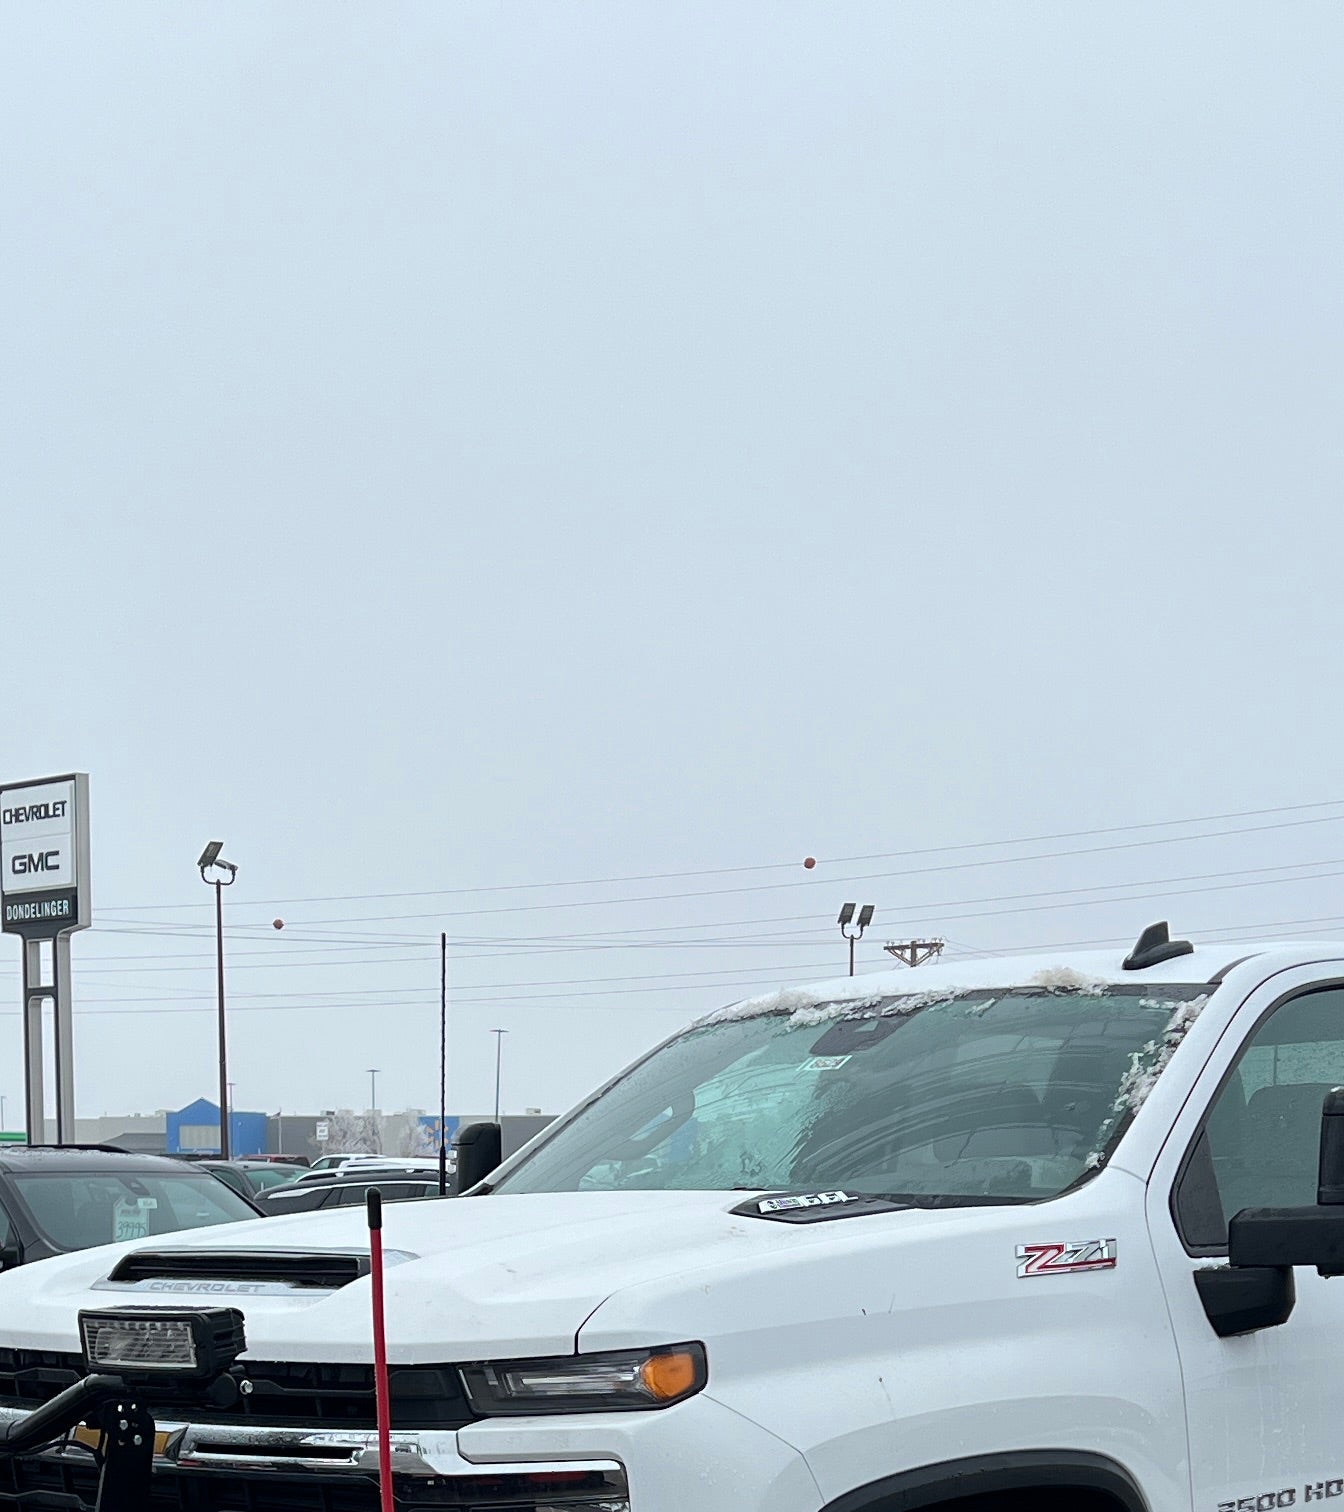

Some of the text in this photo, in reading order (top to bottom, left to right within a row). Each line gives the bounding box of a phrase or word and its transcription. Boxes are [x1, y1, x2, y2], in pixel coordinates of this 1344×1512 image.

[3, 800, 67, 825] CHEVROLET
[12, 850, 60, 875] GMC
[6, 899, 69, 921] DONDELINGER
[1015, 1238, 1117, 1279] Z71
[1304, 1478, 1344, 1503] HD
